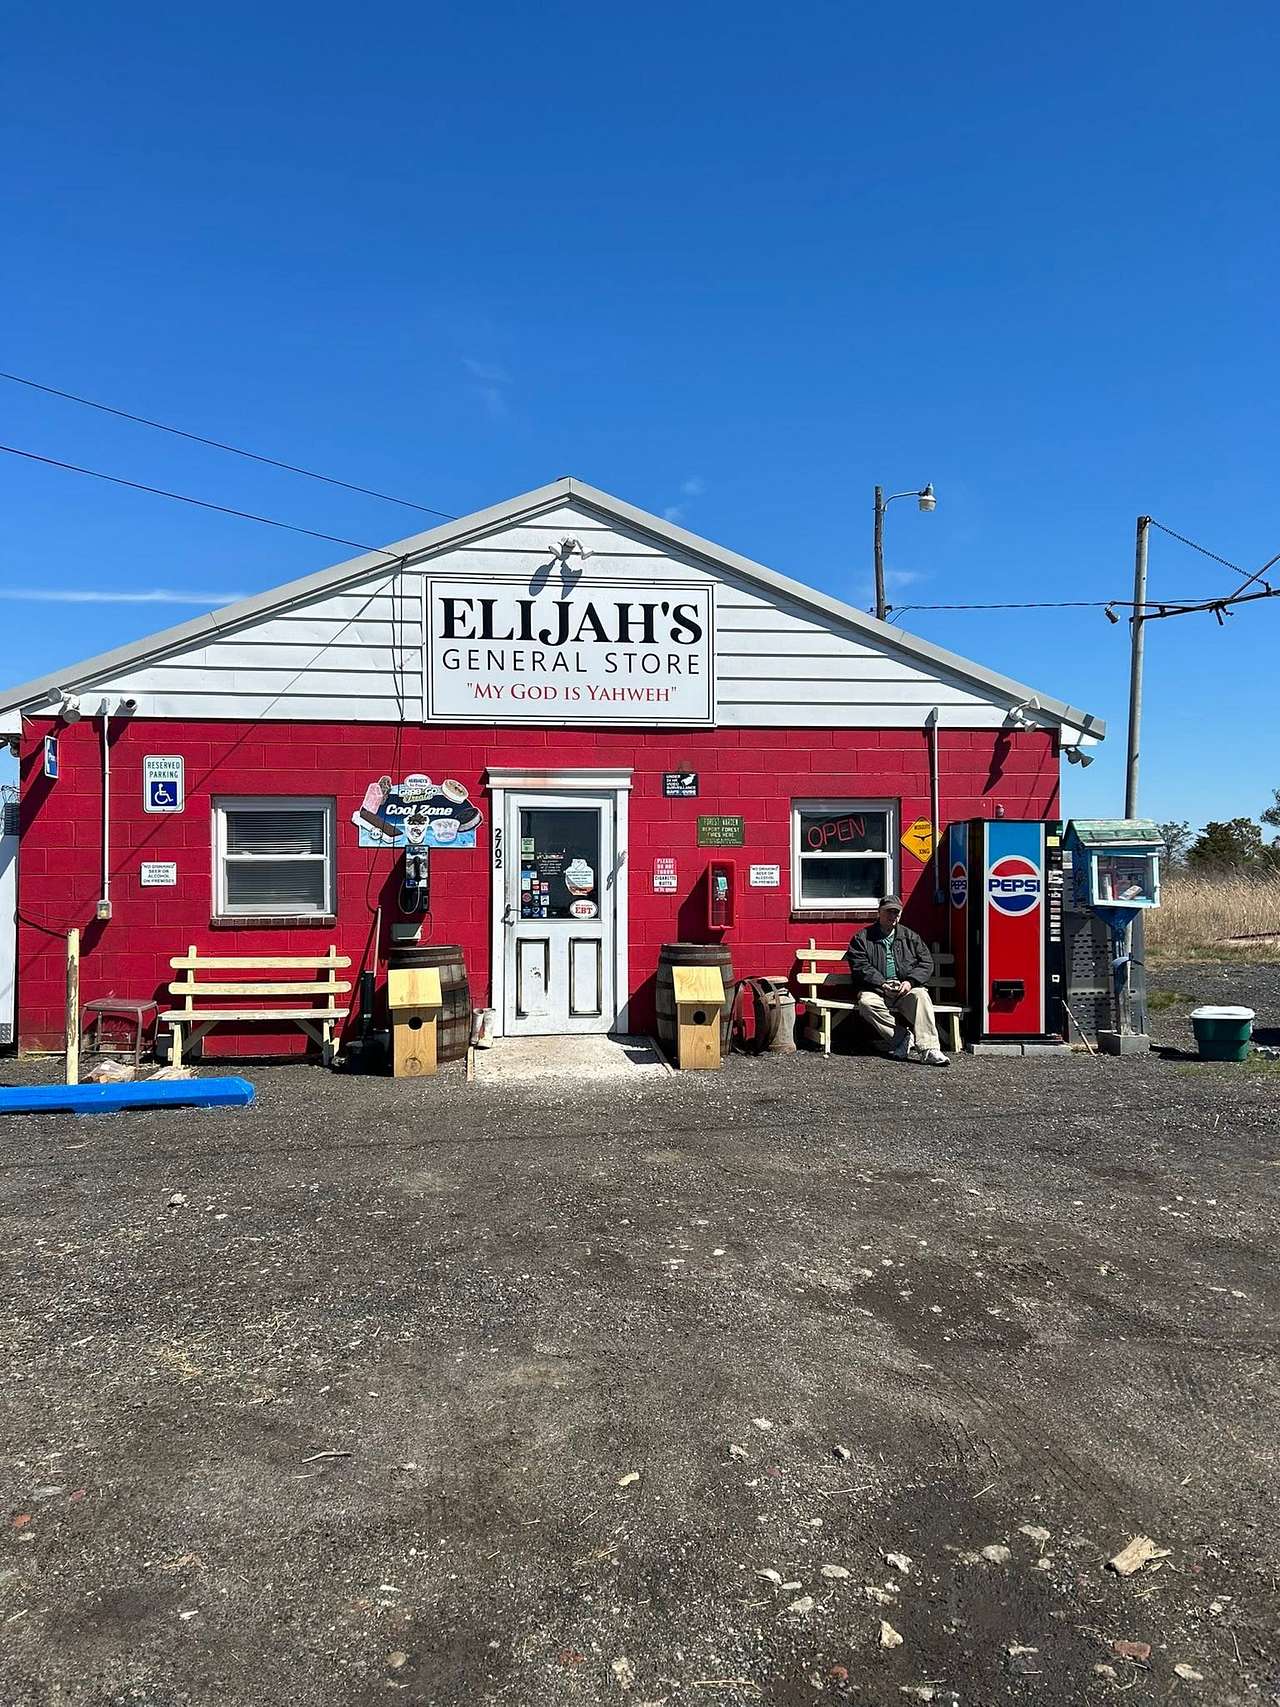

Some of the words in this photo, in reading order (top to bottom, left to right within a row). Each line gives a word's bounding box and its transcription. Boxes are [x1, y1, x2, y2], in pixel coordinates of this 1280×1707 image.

[438, 597, 703, 646] ELIJAH'S
[442, 649, 588, 673] GENERAL
[604, 652, 700, 675] STORE
[147, 761, 181, 770] RESERVED
[149, 771, 179, 779] PARKING
[386, 804, 418, 816] Cool
[419, 804, 453, 816] Zone
[807, 816, 866, 849] OPEN
[494, 828, 502, 869] 2702
[988, 878, 1041, 893] PEPSI
[575, 906, 593, 915] EBT
